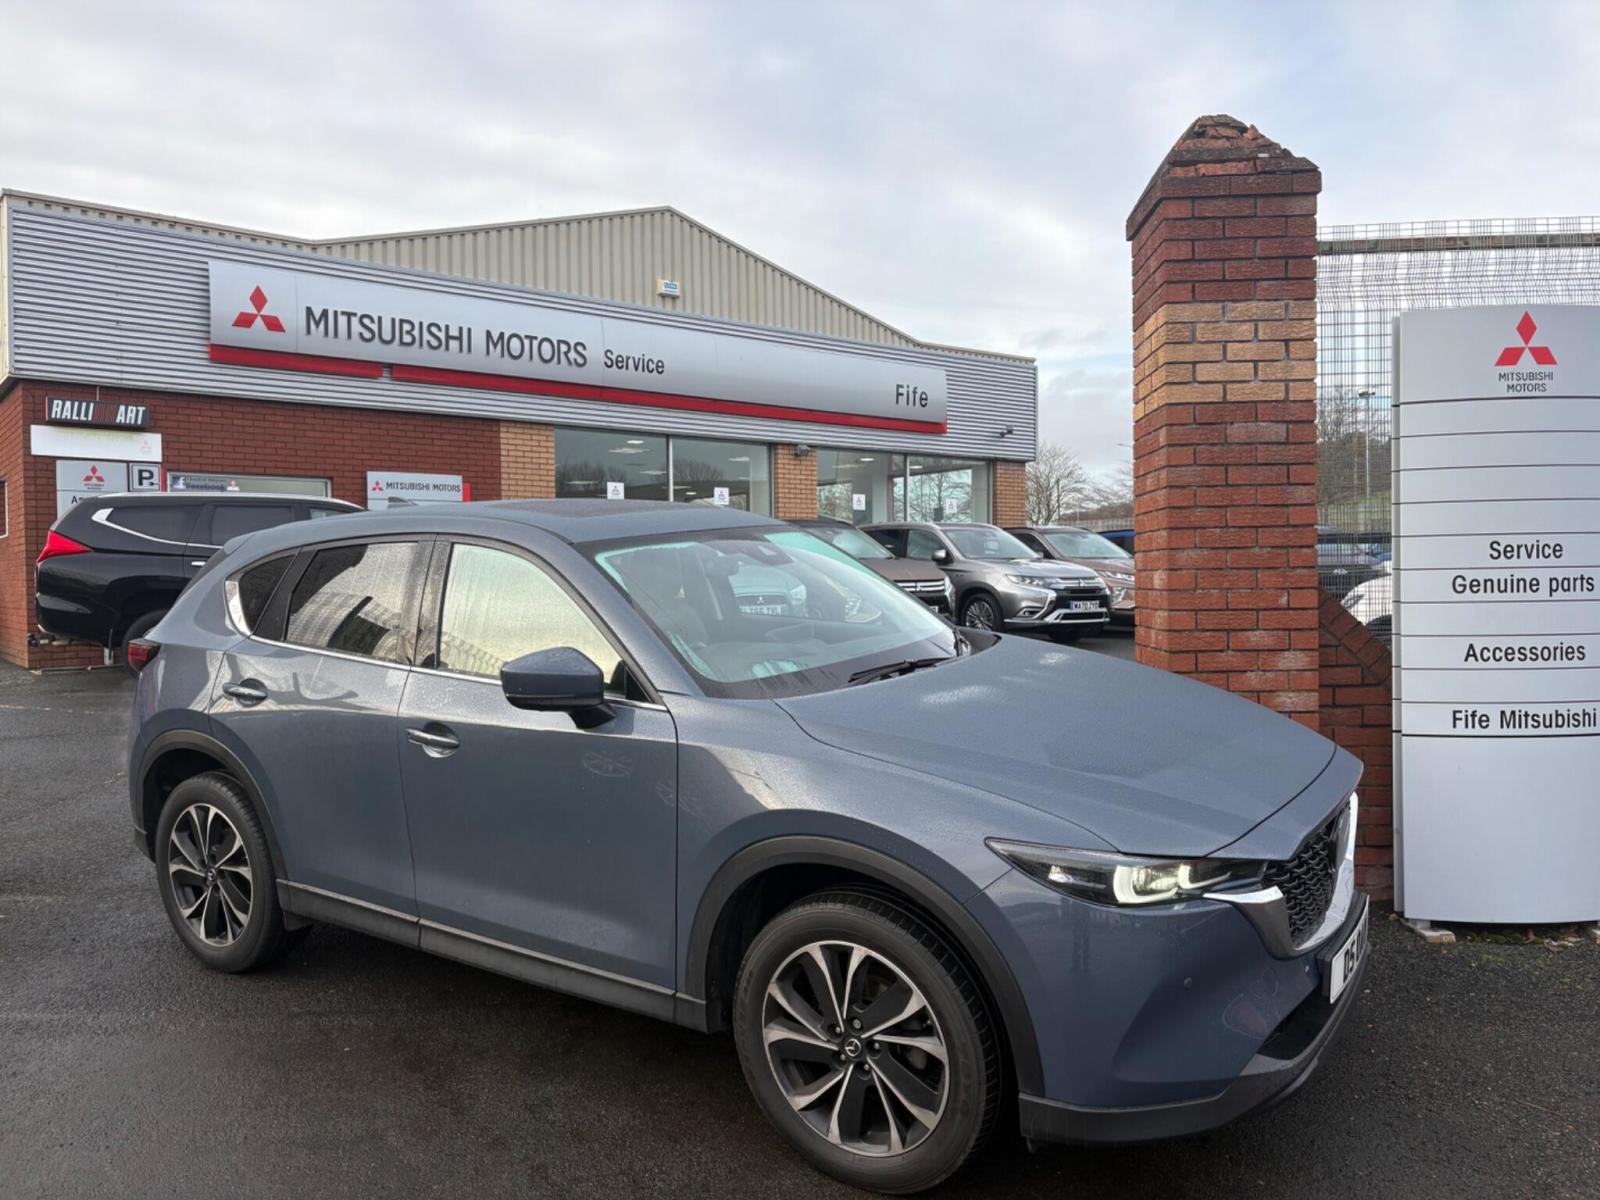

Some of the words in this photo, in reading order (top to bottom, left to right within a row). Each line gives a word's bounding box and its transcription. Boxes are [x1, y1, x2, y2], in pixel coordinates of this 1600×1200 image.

[305, 306, 473, 353] MITSUBISHI
[486, 331, 588, 368] MOTORS
[604, 349, 665, 376] Service
[1498, 371, 1554, 382] MITSUBISHI
[895, 384, 929, 409] Fife
[1506, 383, 1547, 393] MOTORS
[138, 469, 154, 486] P
[386, 481, 430, 491] MITSUBISHI
[433, 483, 461, 493] MOTORS
[1489, 540, 1564, 560] Service
[1452, 574, 1540, 595] Genuine
[1549, 573, 1596, 598] parts
[1464, 642, 1586, 663] Accessories
[1453, 709, 1490, 729] Fife
[1500, 707, 1597, 729] Mitsubishi
